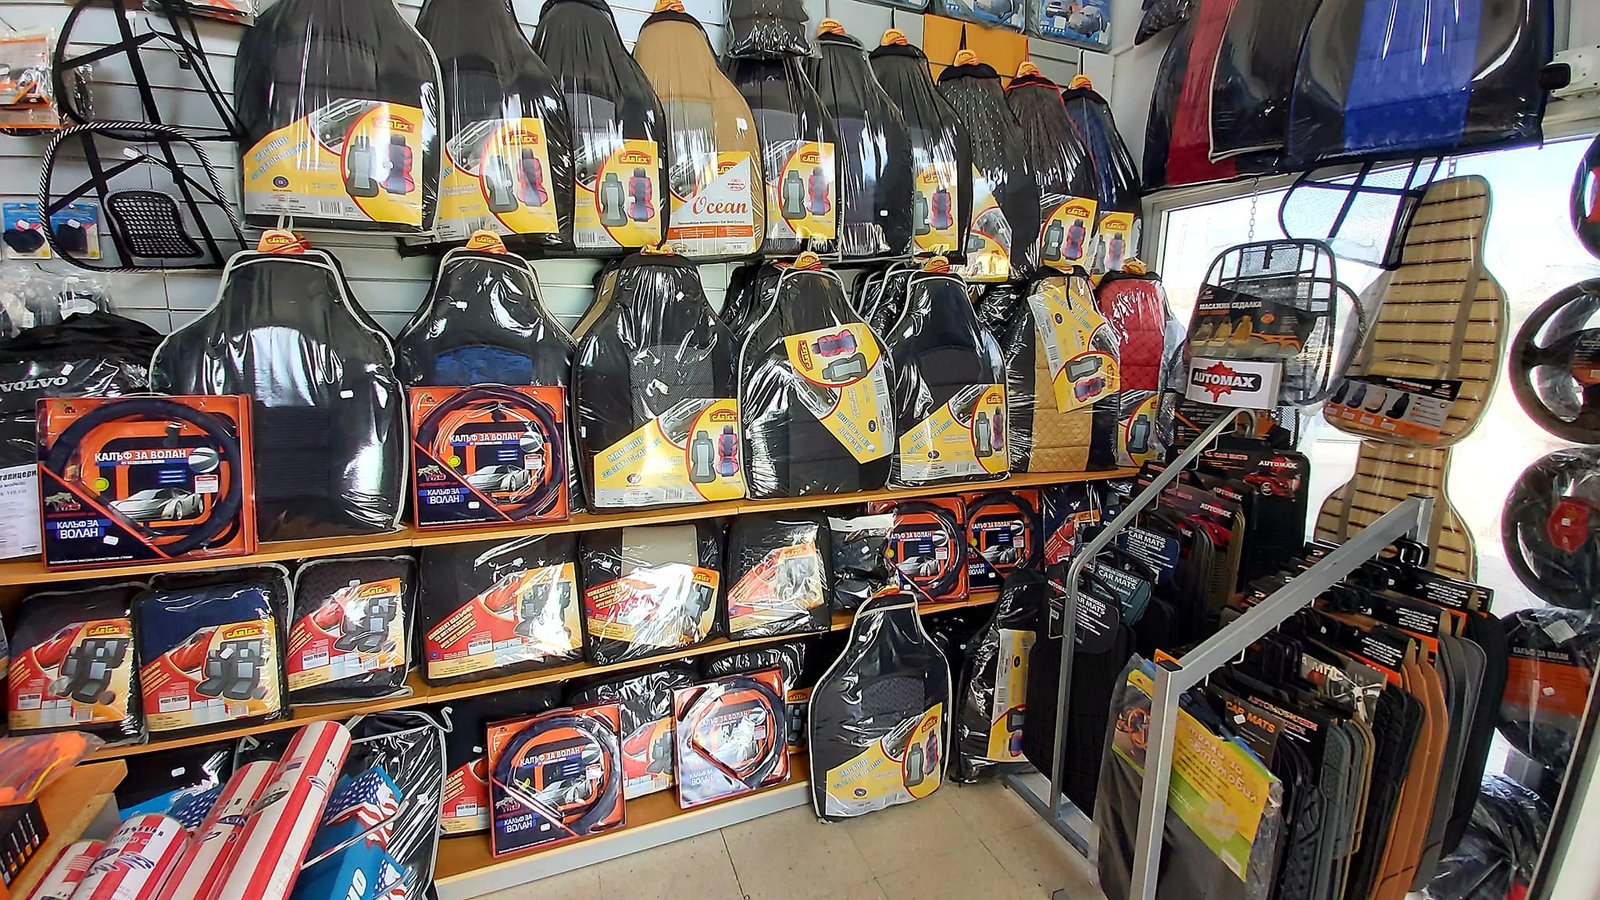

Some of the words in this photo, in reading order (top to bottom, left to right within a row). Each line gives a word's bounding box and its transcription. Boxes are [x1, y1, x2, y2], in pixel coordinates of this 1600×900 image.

[692, 197, 748, 214] Ocean
[0, 377, 68, 392] VOLVO
[1194, 372, 1255, 388] AUTOMAX
[450, 434, 478, 442] КАЛЪФ
[94, 450, 134, 462] КАЛЪФ
[134, 450, 149, 460] ЗА
[151, 449, 187, 460] ВОЛАН
[1258, 460, 1298, 469] AUTOMAX
[430, 495, 460, 504] ВОЛАН
[60, 527, 99, 539] ВОЛАН
[1128, 531, 1144, 542] CAR
[1144, 535, 1166, 549] MATS
[1099, 570, 1114, 582] CAR
[1115, 576, 1136, 590] MATS
[1086, 598, 1106, 615] MATS
[90, 626, 121, 636] CARTEX
[226, 628, 260, 638] CARTEX
[1246, 712, 1276, 734] MATS
[520, 756, 545, 766] КАЛЪФ
[546, 754, 556, 762] ЗА
[556, 748, 580, 760] ВОЛАН
[504, 816, 522, 826] КАЛЪФ
[521, 814, 532, 822] ЗА
[506, 822, 532, 834] ВОЛАН
